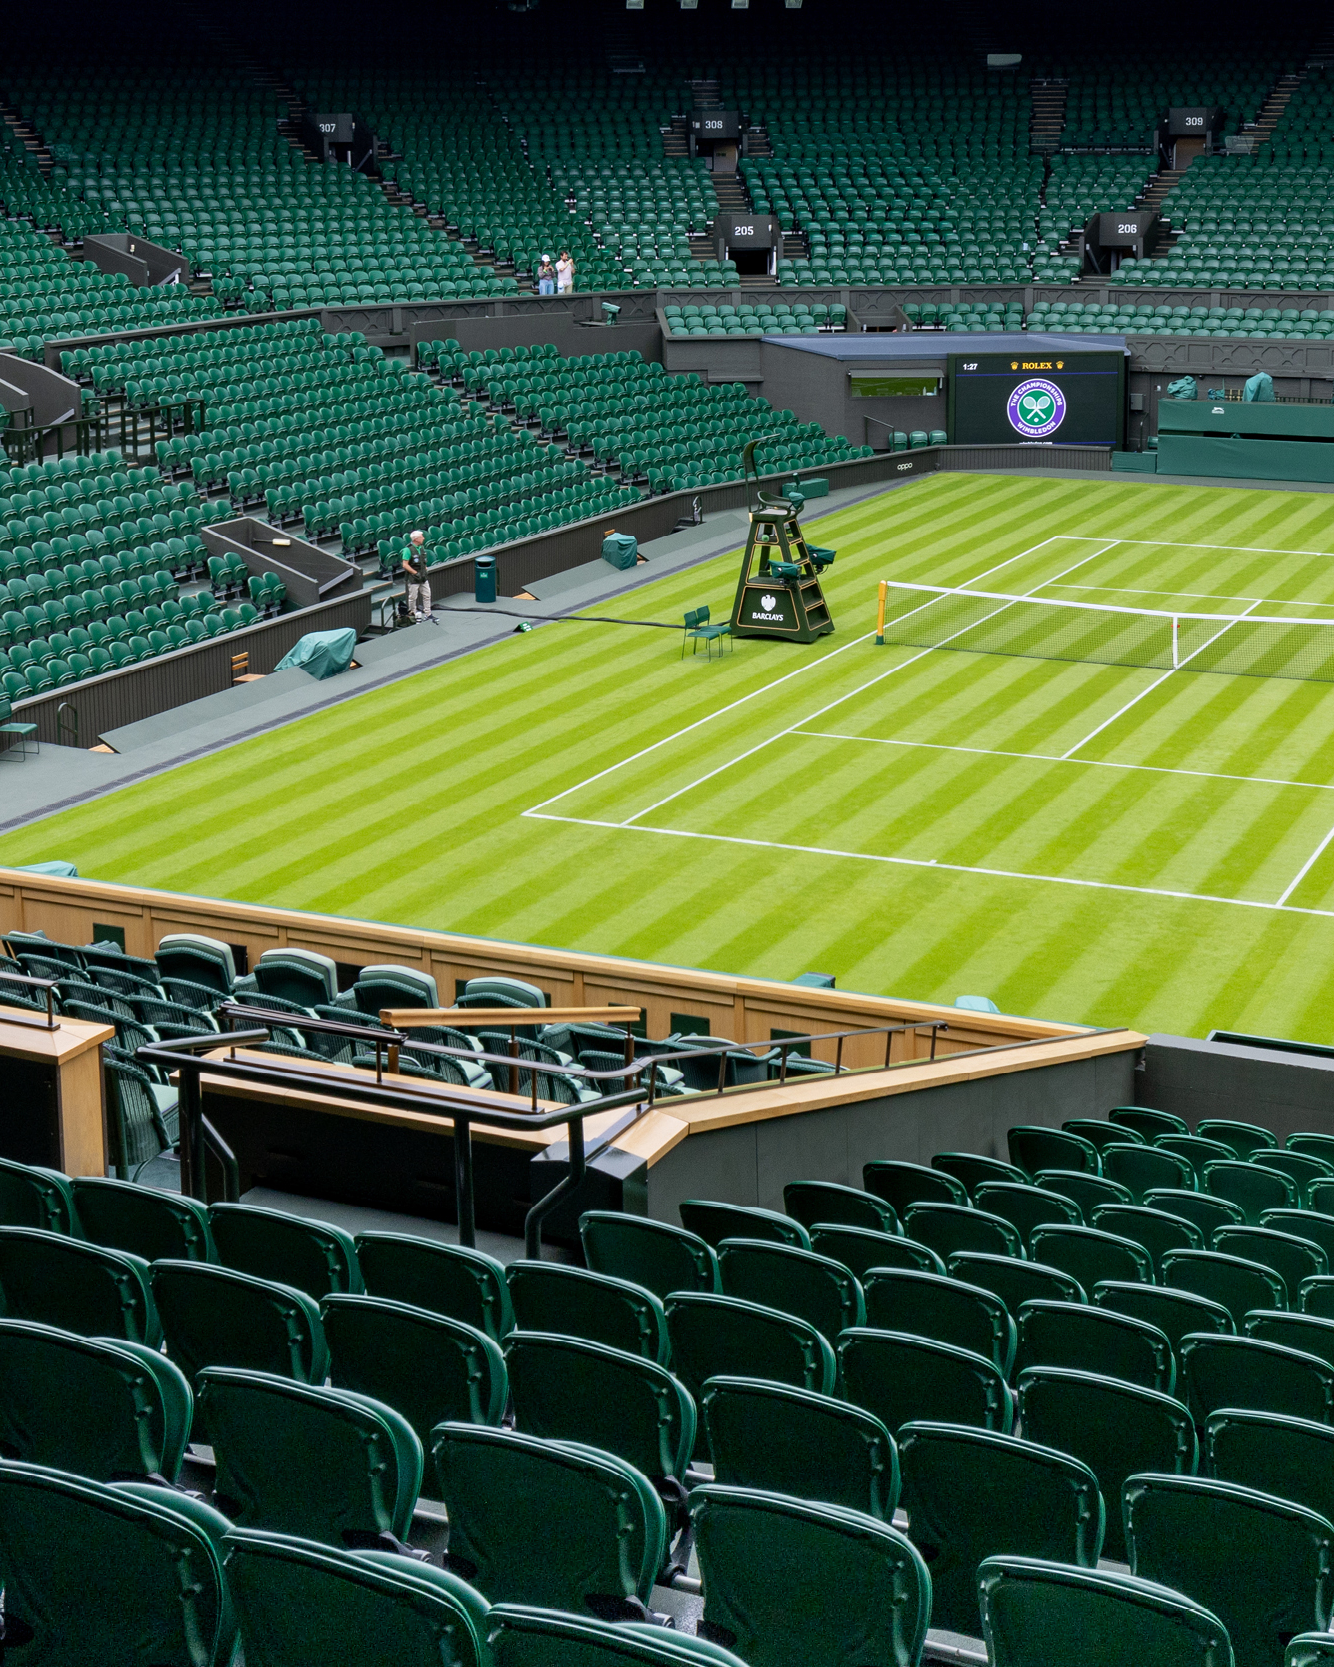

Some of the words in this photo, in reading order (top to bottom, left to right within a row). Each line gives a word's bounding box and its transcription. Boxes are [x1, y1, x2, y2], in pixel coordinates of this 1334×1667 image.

[705, 120, 723, 130] 308
[1185, 117, 1204, 126] 309
[319, 123, 337, 133] 307
[734, 226, 754, 236] 205
[1117, 224, 1137, 234] 206
[962, 363, 978, 371] 1:27
[1022, 362, 1053, 370] ROLEX
[1010, 394, 1020, 407] THE
[1017, 381, 1063, 406] CHAMPIONSHIPS
[1017, 421, 1057, 435] WIMBLEDON
[897, 462, 913, 471] oppo
[752, 612, 784, 622] BARCLAYS
